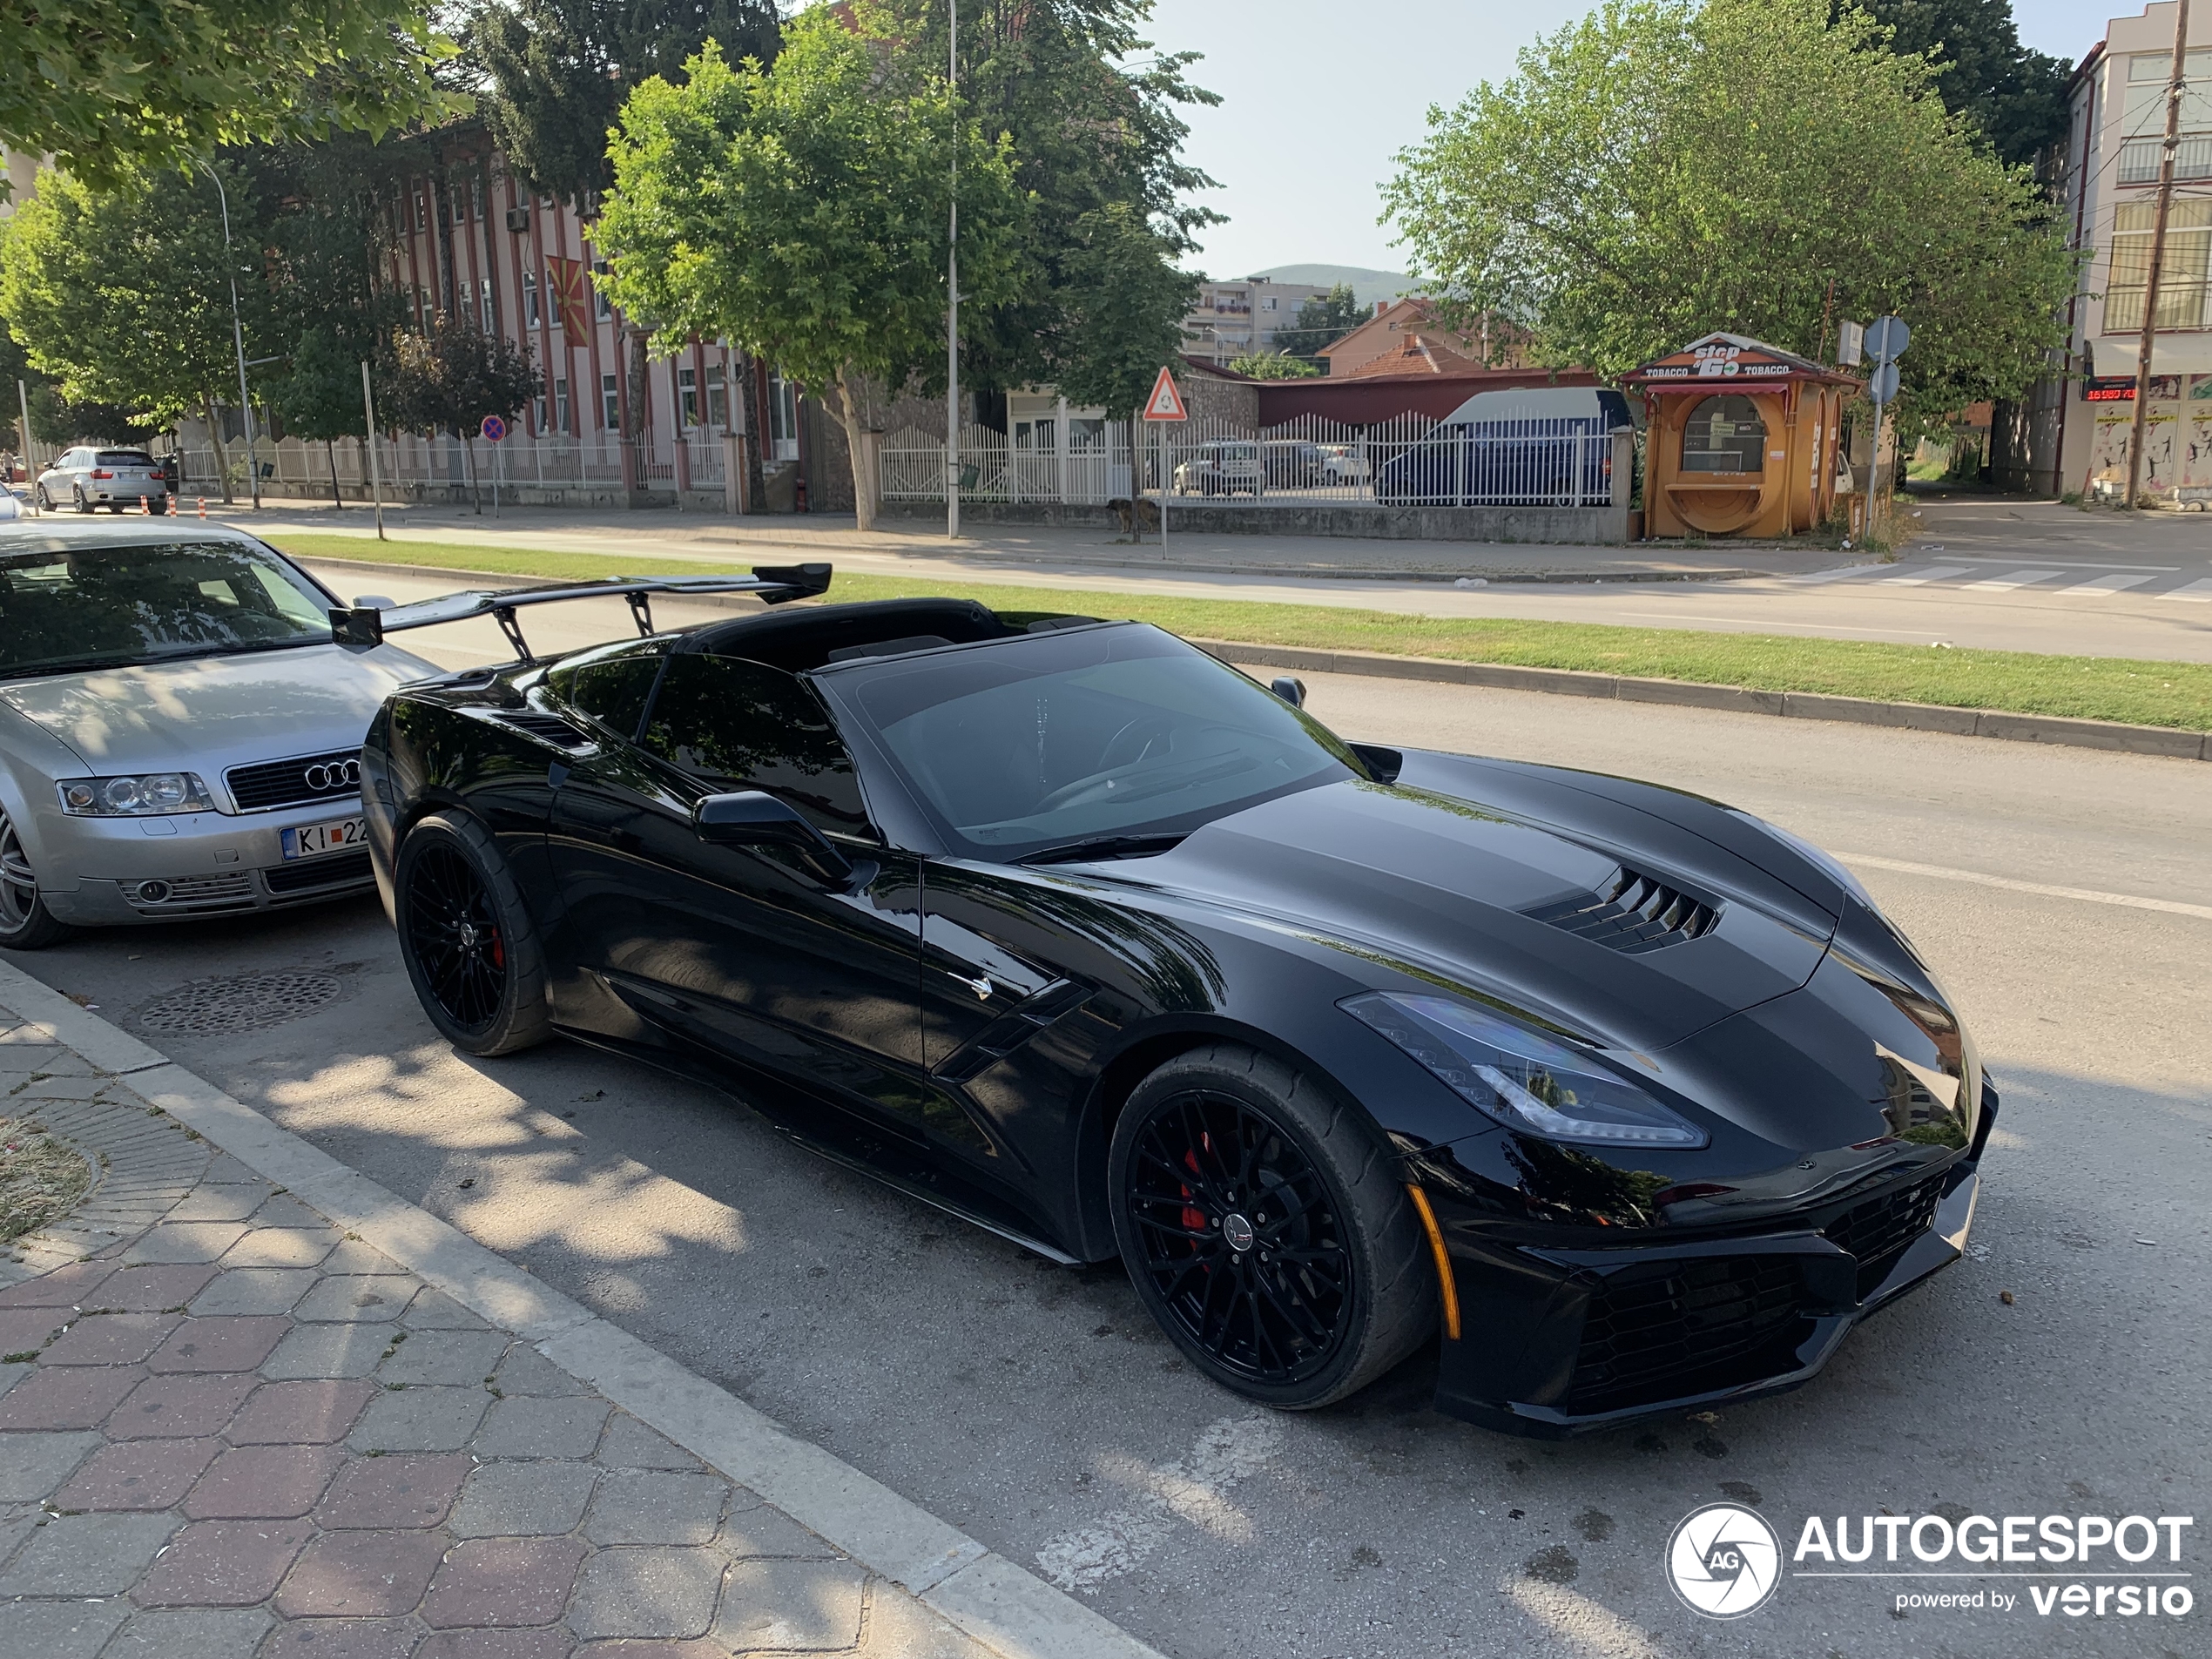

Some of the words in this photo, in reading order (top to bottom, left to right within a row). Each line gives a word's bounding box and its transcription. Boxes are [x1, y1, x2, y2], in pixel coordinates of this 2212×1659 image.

[1646, 368, 1689, 378] TOBACCO
[1744, 365, 1790, 375] TOBACCO
[300, 826, 326, 853] KI
